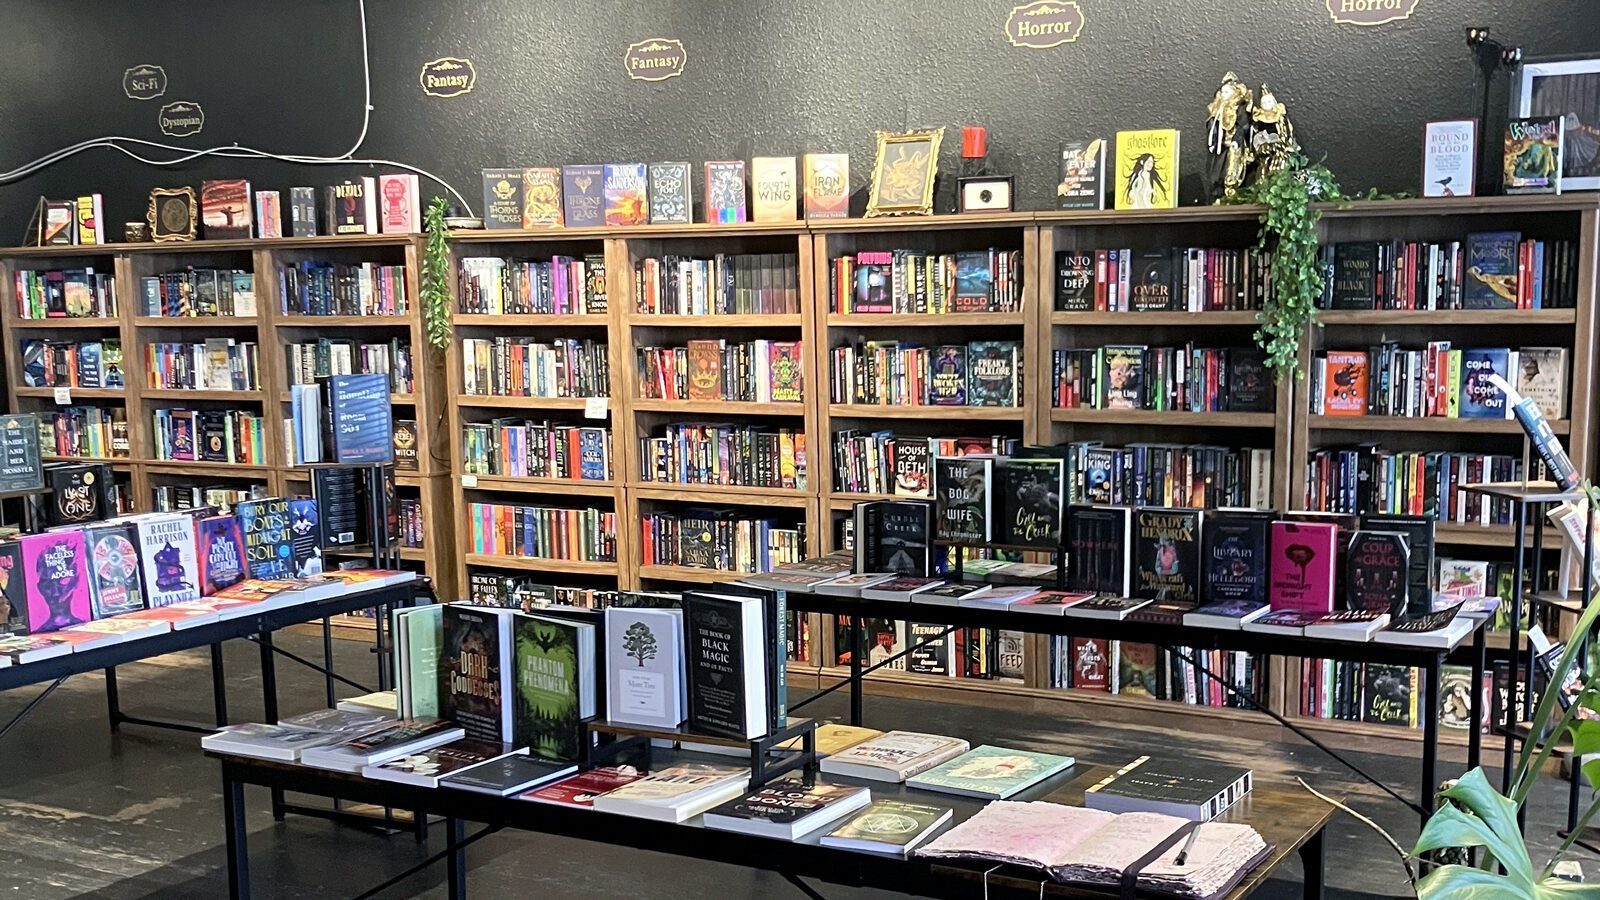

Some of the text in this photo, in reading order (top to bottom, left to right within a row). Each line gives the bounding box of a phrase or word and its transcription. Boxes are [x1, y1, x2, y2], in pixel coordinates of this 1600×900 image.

[1340, 0, 1401, 12] Horror
[1017, 20, 1071, 37] Horror
[631, 56, 680, 70] Fantasy
[132, 78, 158, 91] Sci-Fi
[427, 73, 469, 88] Fantasy
[162, 116, 201, 129] Dystopian
[1431, 133, 1469, 142] BOUND
[1430, 144, 1469, 154] BLOOD
[1067, 161, 1096, 169] EATER
[655, 179, 681, 189] ECHO
[757, 181, 791, 192] FOURTH
[815, 177, 840, 187] IRON
[335, 184, 362, 198] DEVILS
[758, 191, 791, 202] WING
[813, 188, 843, 197] FLAME
[489, 205, 519, 214] THORNS
[1065, 256, 1090, 267] INTO
[1064, 279, 1090, 289] DEEP
[1134, 286, 1168, 296] OVER
[1328, 355, 1366, 364] TANTRUM
[1466, 361, 1490, 369] COME
[1475, 386, 1499, 395] COME
[1486, 399, 1503, 408] OUT
[395, 448, 415, 456] WITCH
[898, 446, 926, 456] HOUSE
[2, 466, 33, 474] MONSTER
[898, 460, 926, 474] BETH
[1088, 460, 1111, 470] KING
[948, 466, 968, 479] THE
[64, 485, 90, 499] LAST
[948, 487, 969, 500] BOG
[65, 503, 91, 514] ONE
[269, 502, 289, 513] OUR
[947, 509, 972, 521] WIFE
[1140, 513, 1182, 527] GRADY
[151, 523, 182, 534] RACHEL
[244, 515, 283, 533] BONES
[684, 519, 709, 530] HEIR
[885, 523, 917, 532] CREEK
[146, 531, 188, 546] HARRISON
[246, 528, 291, 546] MIDNIGHT
[950, 531, 982, 540] Chronister
[1141, 526, 1193, 541] HENDRIX
[247, 545, 277, 561] SOIL
[1213, 546, 1253, 559] LIBRARY
[1362, 543, 1393, 553] COUP
[45, 550, 74, 560] FACELESS
[1363, 554, 1400, 566] GRACE
[45, 558, 66, 567] THING
[51, 570, 74, 580] ADORE
[1208, 572, 1257, 583] HELLEBORE
[1286, 573, 1300, 581] THE
[481, 585, 498, 593] FALLEN
[1274, 582, 1312, 591] MIDNIGHT
[153, 591, 194, 608] PLAY NICE
[779, 601, 787, 623] FOREST
[699, 628, 709, 636] THE
[709, 630, 724, 638] BOOK
[911, 623, 945, 635] TEENAGE
[702, 638, 729, 653] BLACK
[702, 649, 730, 664] MAGIC
[1000, 653, 1023, 669] FEED
[460, 652, 488, 679] DARK
[527, 655, 565, 679] PHANTOM
[451, 670, 500, 706] GODDESSES
[523, 671, 570, 697] PHENOMENA
